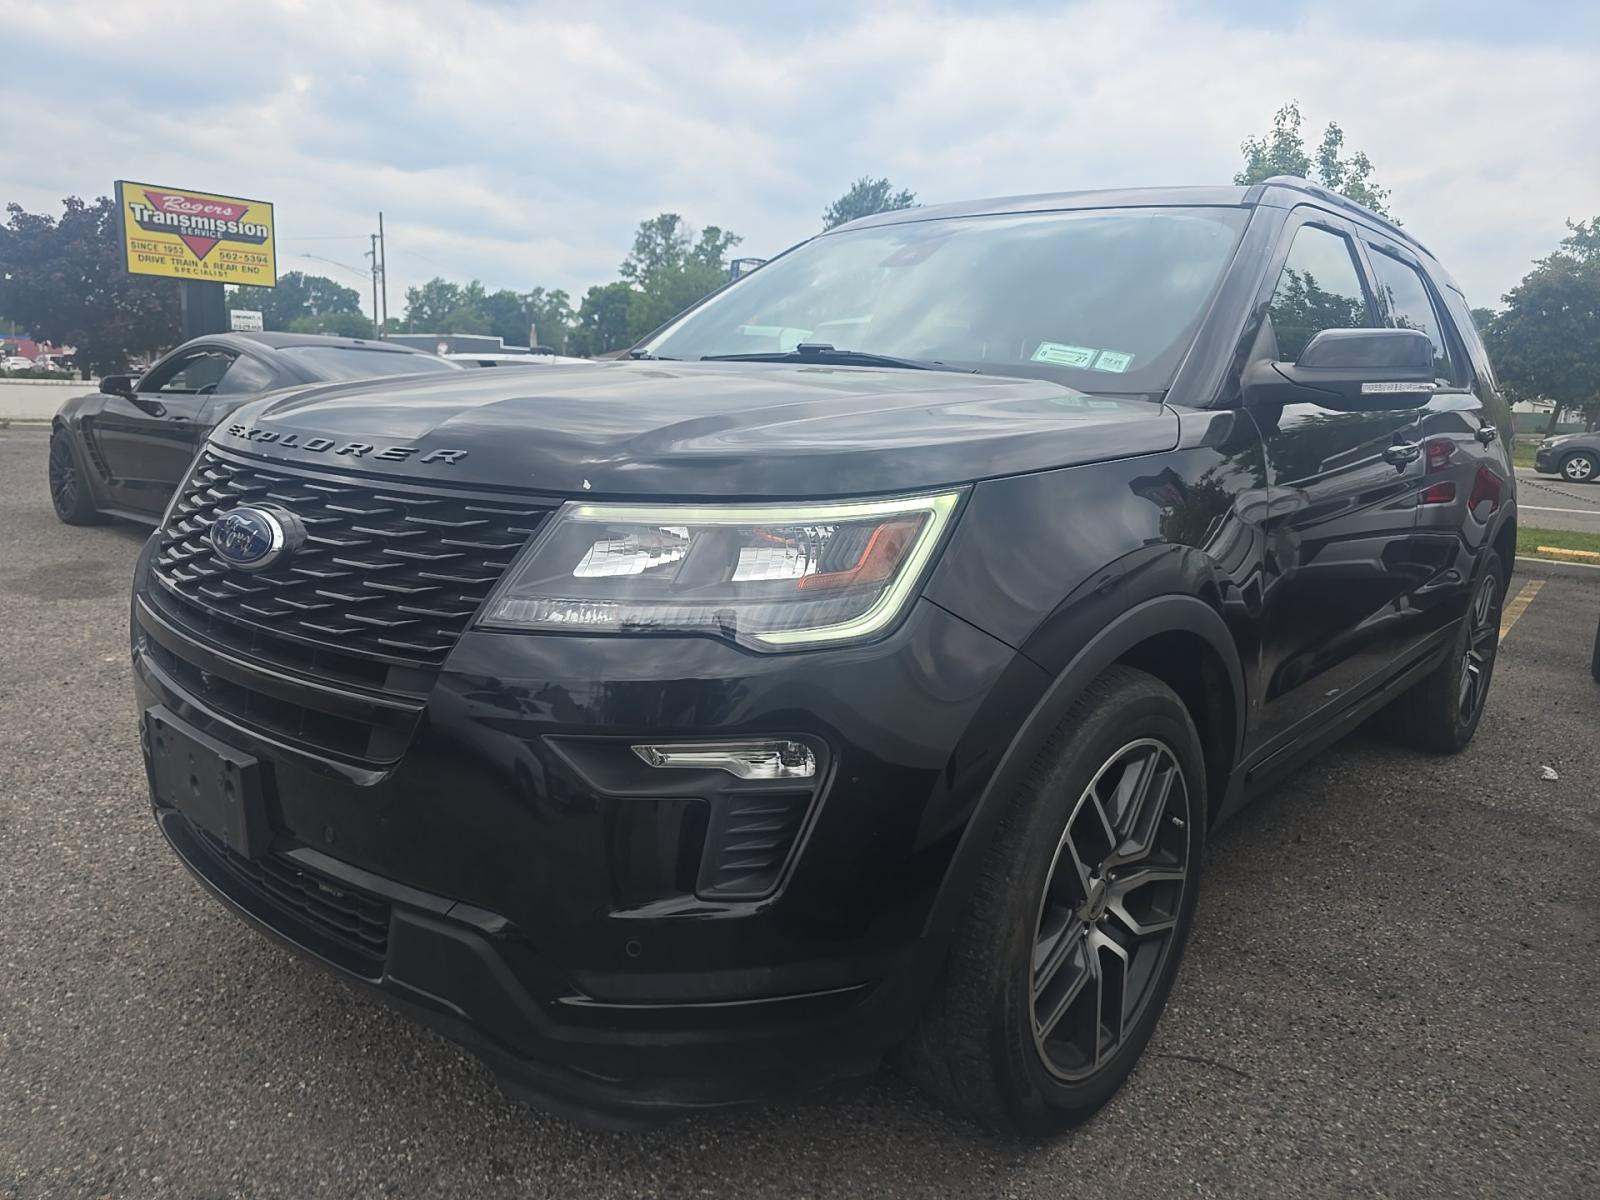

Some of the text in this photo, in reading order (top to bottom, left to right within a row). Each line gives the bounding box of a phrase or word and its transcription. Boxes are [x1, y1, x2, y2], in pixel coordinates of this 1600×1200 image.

[162, 195, 234, 216] Rogers
[130, 203, 268, 238] Transmission
[180, 226, 223, 239] SERVICE
[131, 241, 159, 251] SINCE
[138, 254, 166, 265] DRIVE
[172, 258, 199, 267] TRAIN
[213, 262, 238, 271] REAR
[242, 265, 260, 274] END
[174, 266, 228, 277] SPECIALIST
[227, 423, 468, 465] EXPLORER
